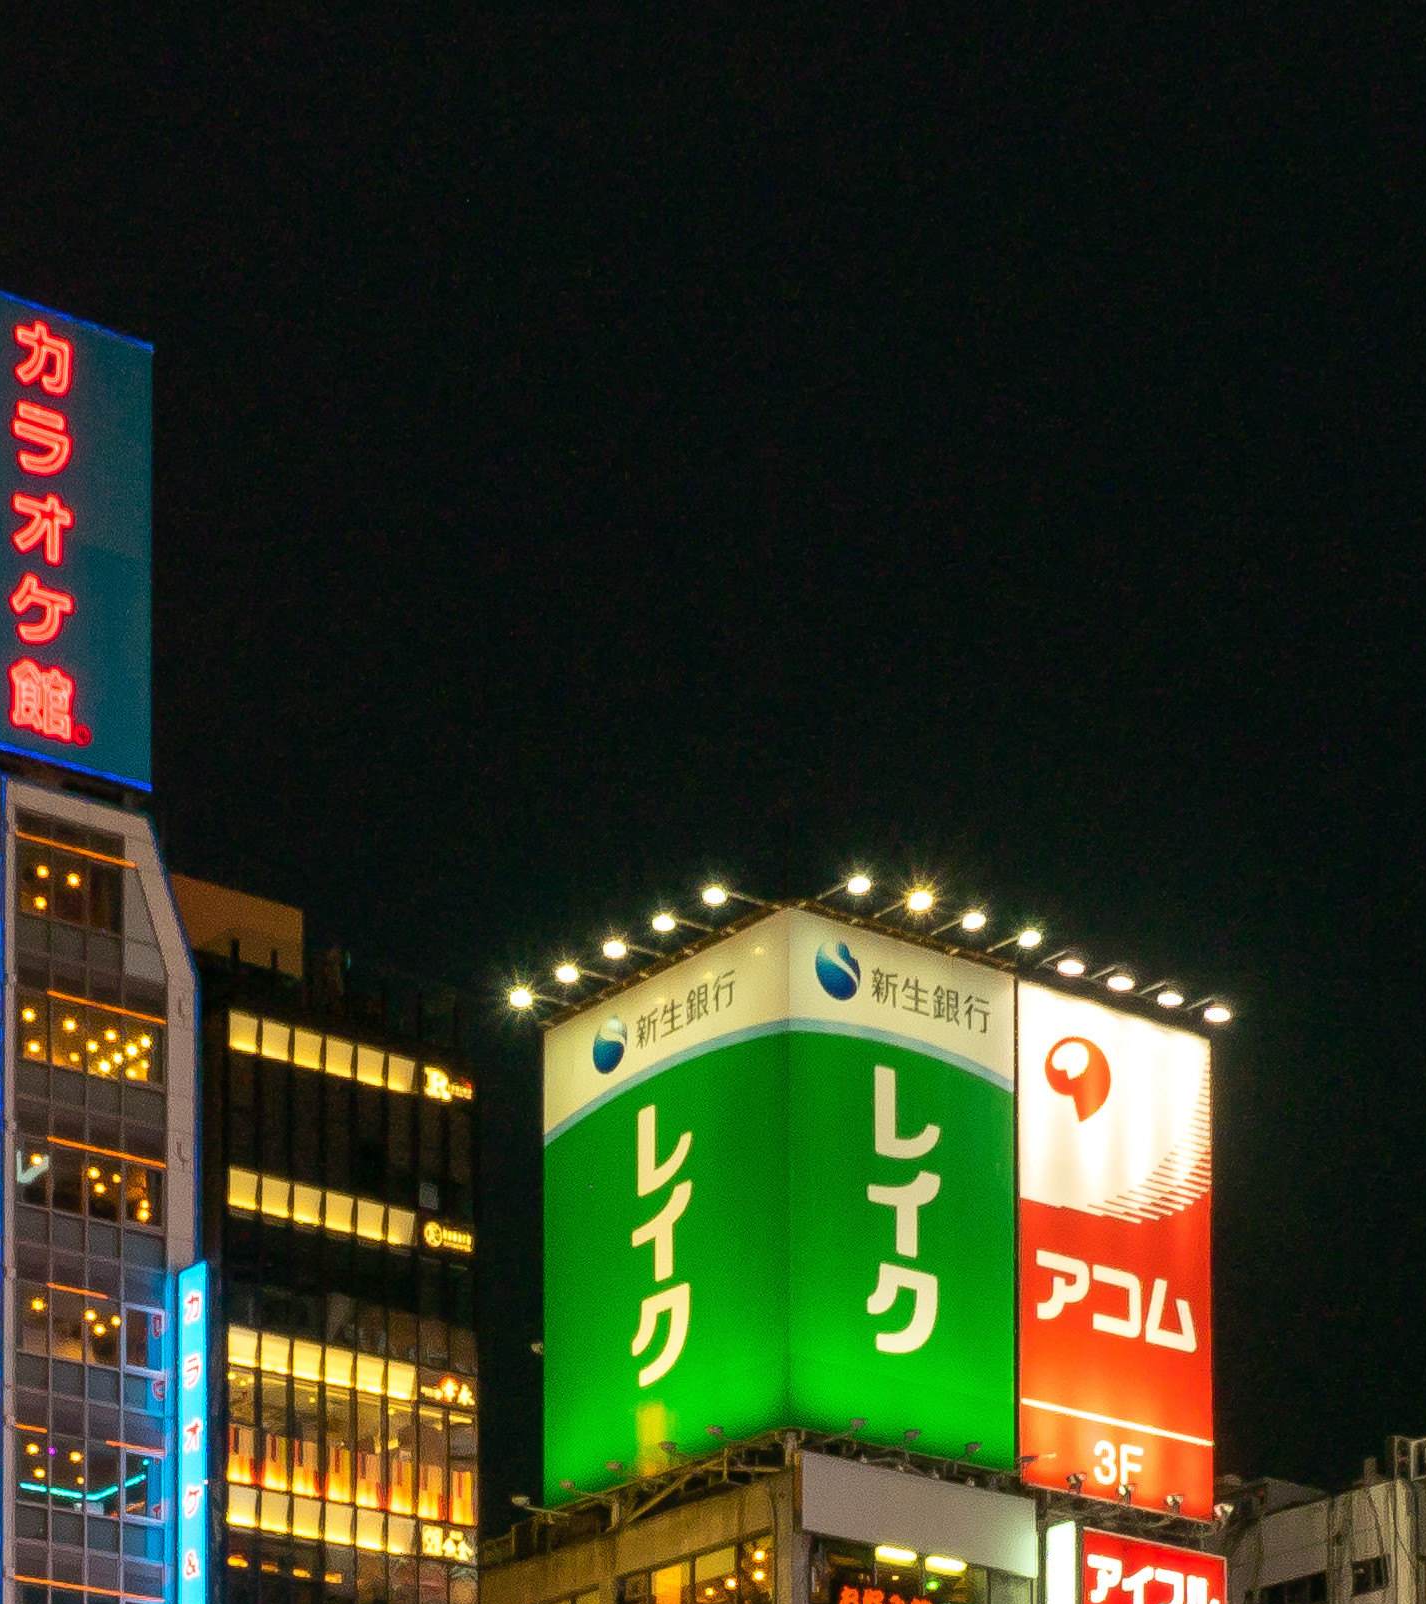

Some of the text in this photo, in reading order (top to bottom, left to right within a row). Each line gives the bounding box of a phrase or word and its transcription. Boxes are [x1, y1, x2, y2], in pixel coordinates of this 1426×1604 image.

[11, 319, 75, 742] カラオケ館
[635, 969, 737, 1050] 新生銀行
[871, 967, 991, 1036] 新生銀行
[631, 1103, 692, 1388] レイク
[866, 1065, 941, 1355] レイク
[1036, 1249, 1197, 1353] アコム
[1092, 1441, 1144, 1488] 3F
